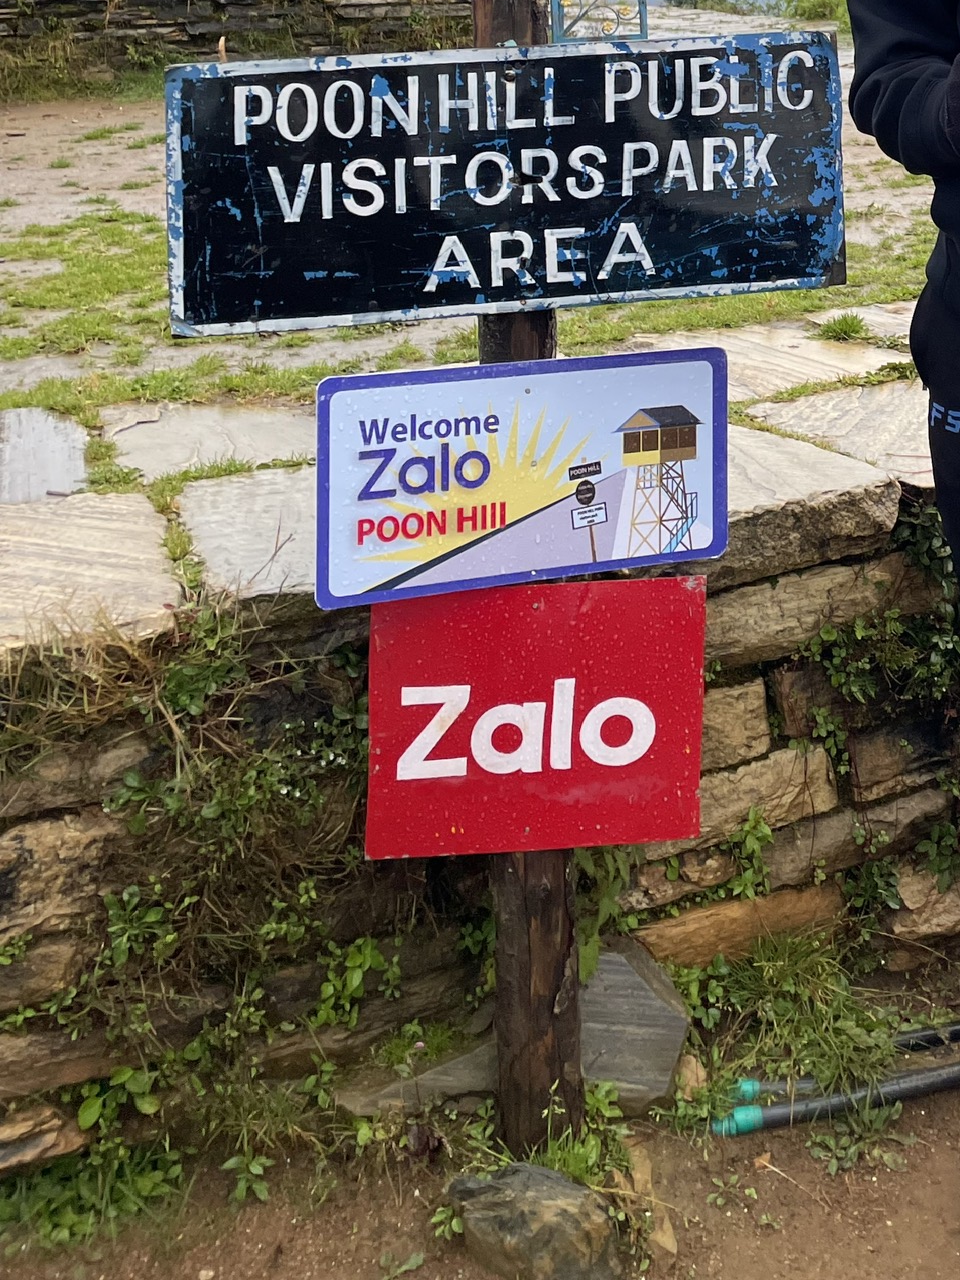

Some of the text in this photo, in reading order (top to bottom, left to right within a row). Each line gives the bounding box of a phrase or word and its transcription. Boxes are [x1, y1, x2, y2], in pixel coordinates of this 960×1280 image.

[232, 75, 419, 146] POON
[438, 67, 575, 134] HILL
[422, 221, 656, 293] AREA
[359, 414, 500, 445] Welcome
[357, 442, 491, 501] Zalo
[357, 510, 447, 545] POON
[396, 678, 656, 781] Zalo
